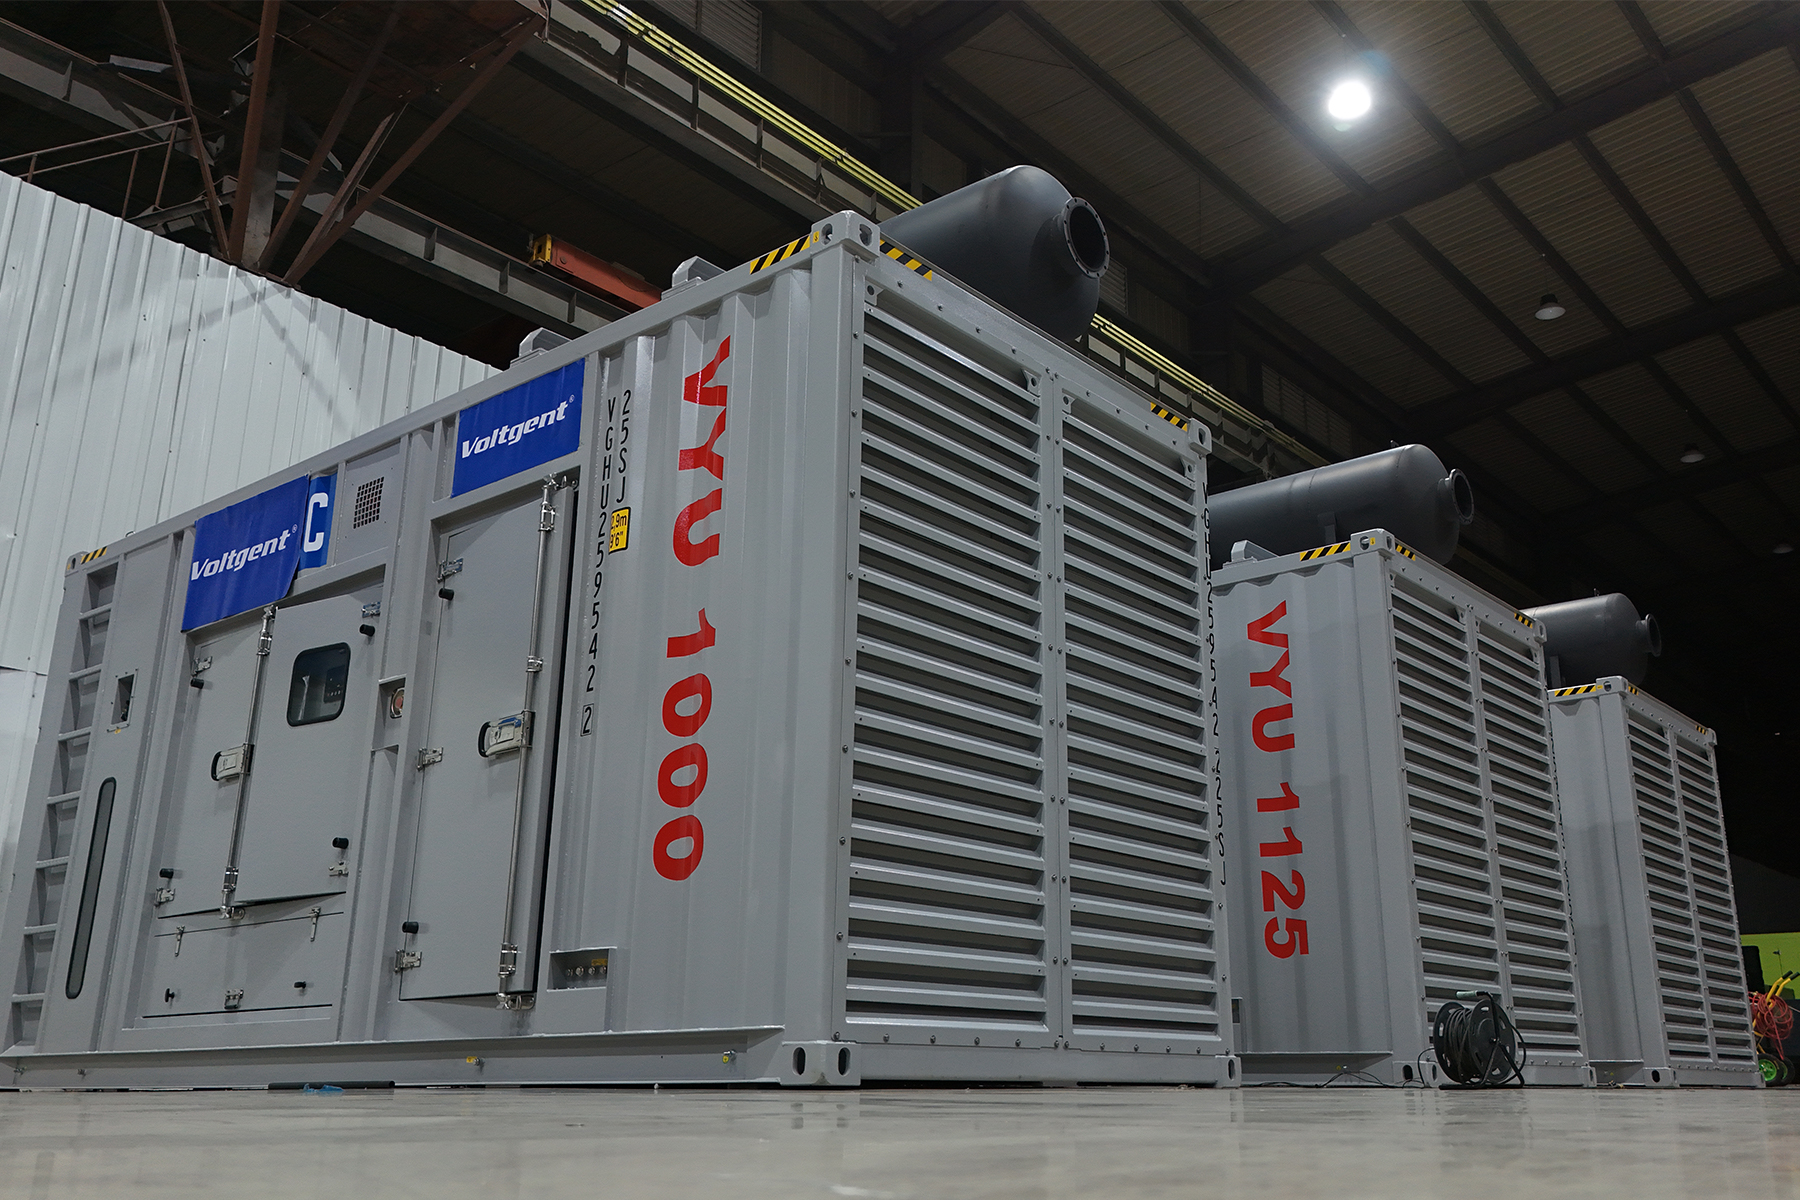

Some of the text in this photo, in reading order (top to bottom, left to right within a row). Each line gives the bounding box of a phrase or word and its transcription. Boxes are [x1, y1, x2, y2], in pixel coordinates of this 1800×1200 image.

[303, 492, 328, 553] C
[616, 389, 631, 503] 25SJ
[653, 336, 730, 881] VYU 1000
[1247, 601, 1308, 958] VYU 1125
